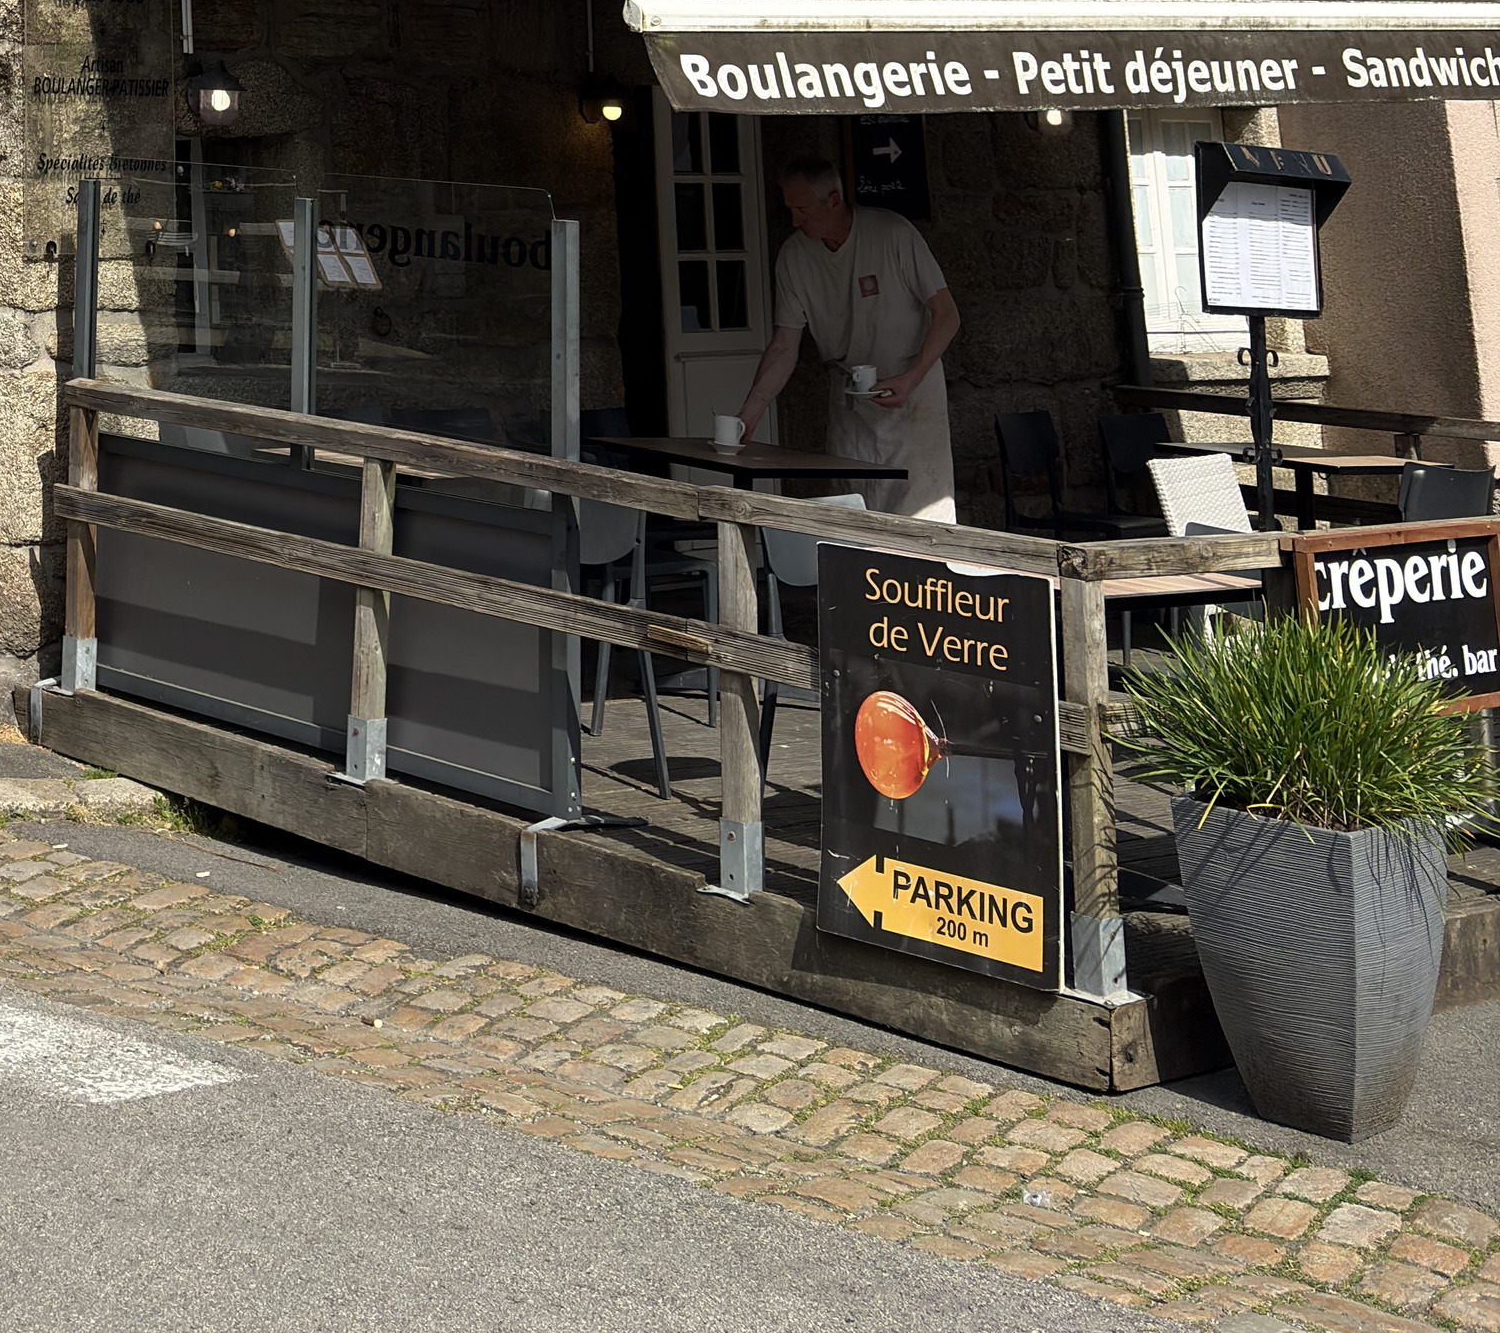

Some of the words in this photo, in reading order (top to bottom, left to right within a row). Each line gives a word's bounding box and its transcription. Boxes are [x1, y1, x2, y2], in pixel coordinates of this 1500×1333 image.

[81, 55, 124, 73] Artisan
[679, 50, 972, 108] Boulangerie
[1012, 49, 1115, 95] Petit
[1125, 46, 1298, 104] déjeuner
[37, 152, 105, 174] Spécialités
[109, 154, 168, 171] Bretonnes
[103, 187, 117, 204] de
[122, 185, 141, 204] thé
[865, 568, 1010, 623] Souffleur
[1314, 538, 1488, 624] crêperie
[868, 616, 909, 652] de
[917, 622, 1009, 671] Verre
[1461, 644, 1498, 676] bar
[892, 869, 1034, 934] PARKING
[936, 916, 967, 941] 200
[972, 929, 989, 948] m
